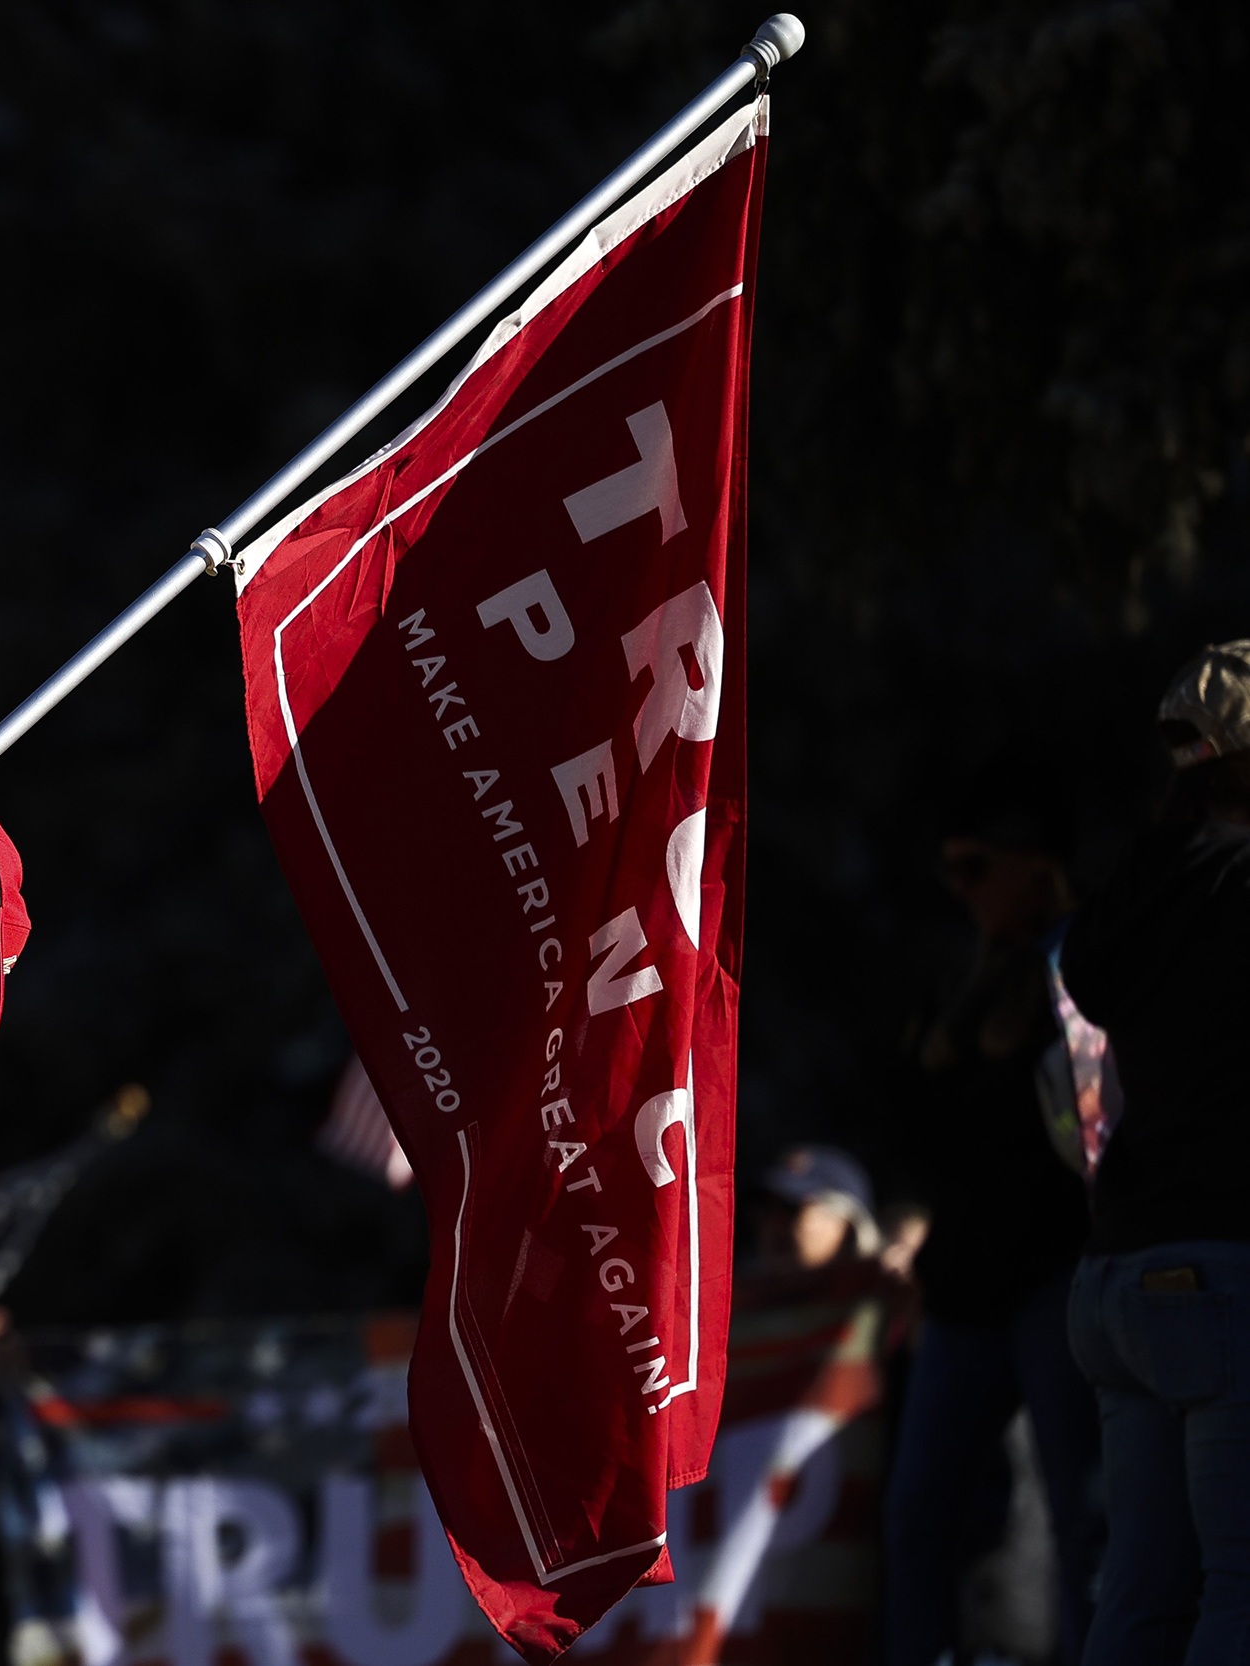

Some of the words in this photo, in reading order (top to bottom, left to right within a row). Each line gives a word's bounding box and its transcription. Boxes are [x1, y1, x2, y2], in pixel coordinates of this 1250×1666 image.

[398, 606, 481, 751] MAKE
[462, 769, 565, 1013] AMERICA
[540, 1027, 603, 1193] GREAT
[580, 1223, 673, 1416] AGAIN!
[401, 1025, 461, 1113] 2020
[475, 568, 689, 1189] PENC
